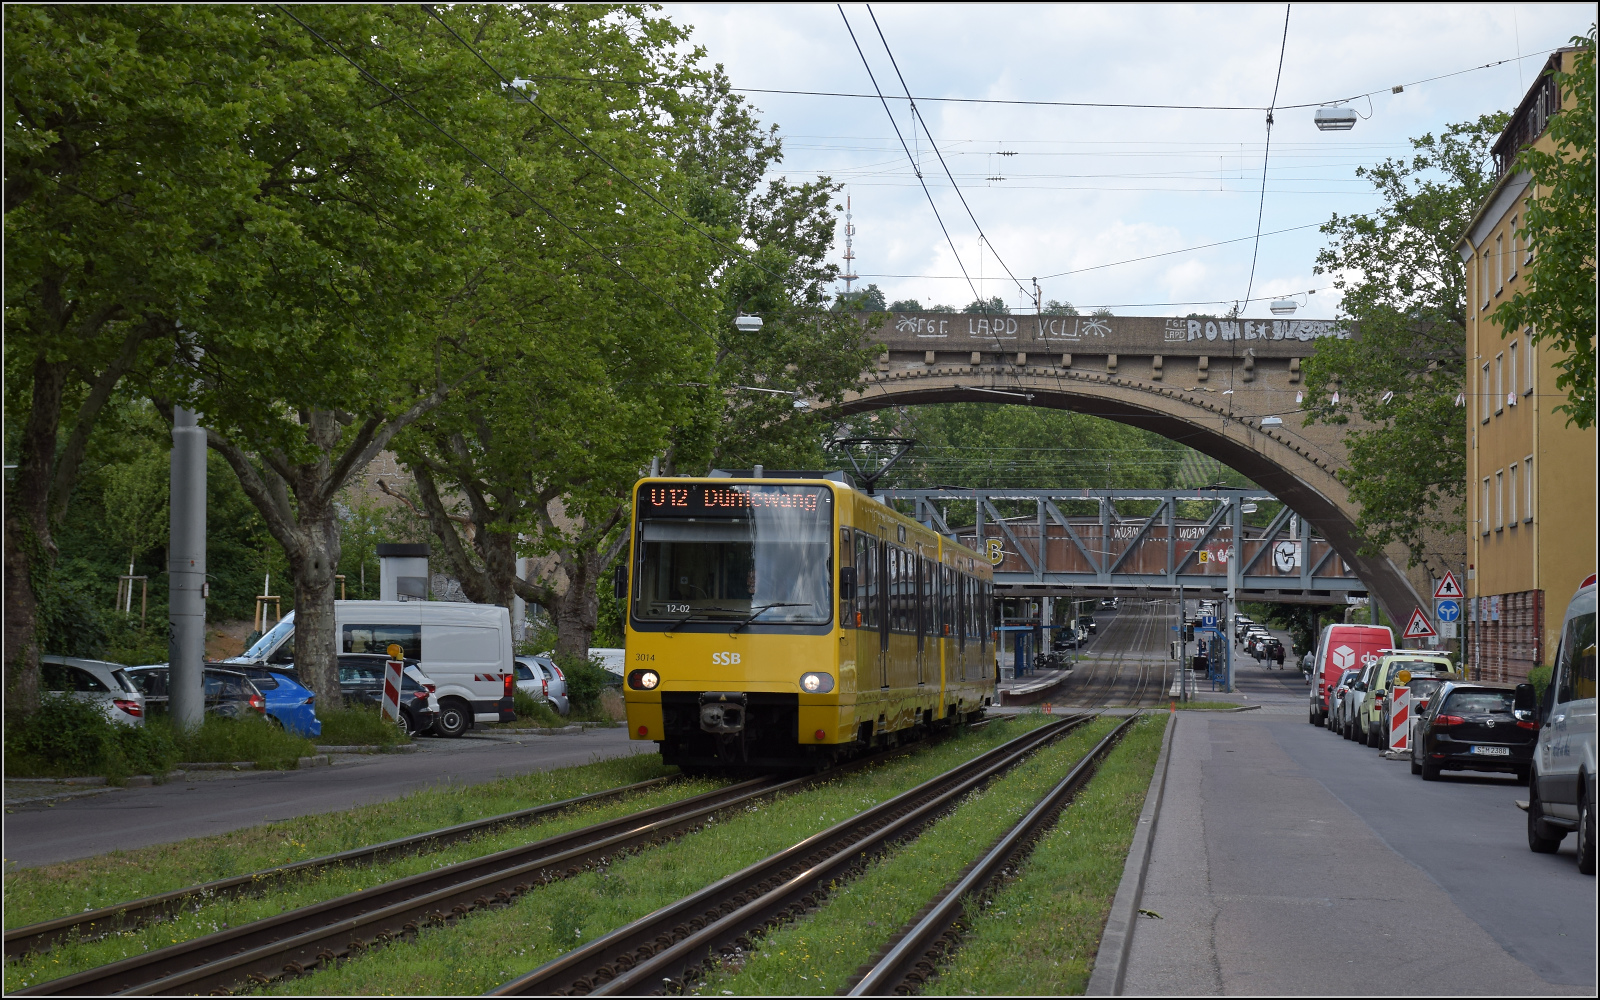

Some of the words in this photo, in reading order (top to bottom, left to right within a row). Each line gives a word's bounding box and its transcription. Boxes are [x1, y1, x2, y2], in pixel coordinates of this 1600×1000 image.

[1200, 552, 1208, 562] 3
[667, 604, 690, 613] 12-02
[1205, 616, 1214, 625] U
[635, 653, 655, 662] 3014
[712, 651, 741, 666] SSB
